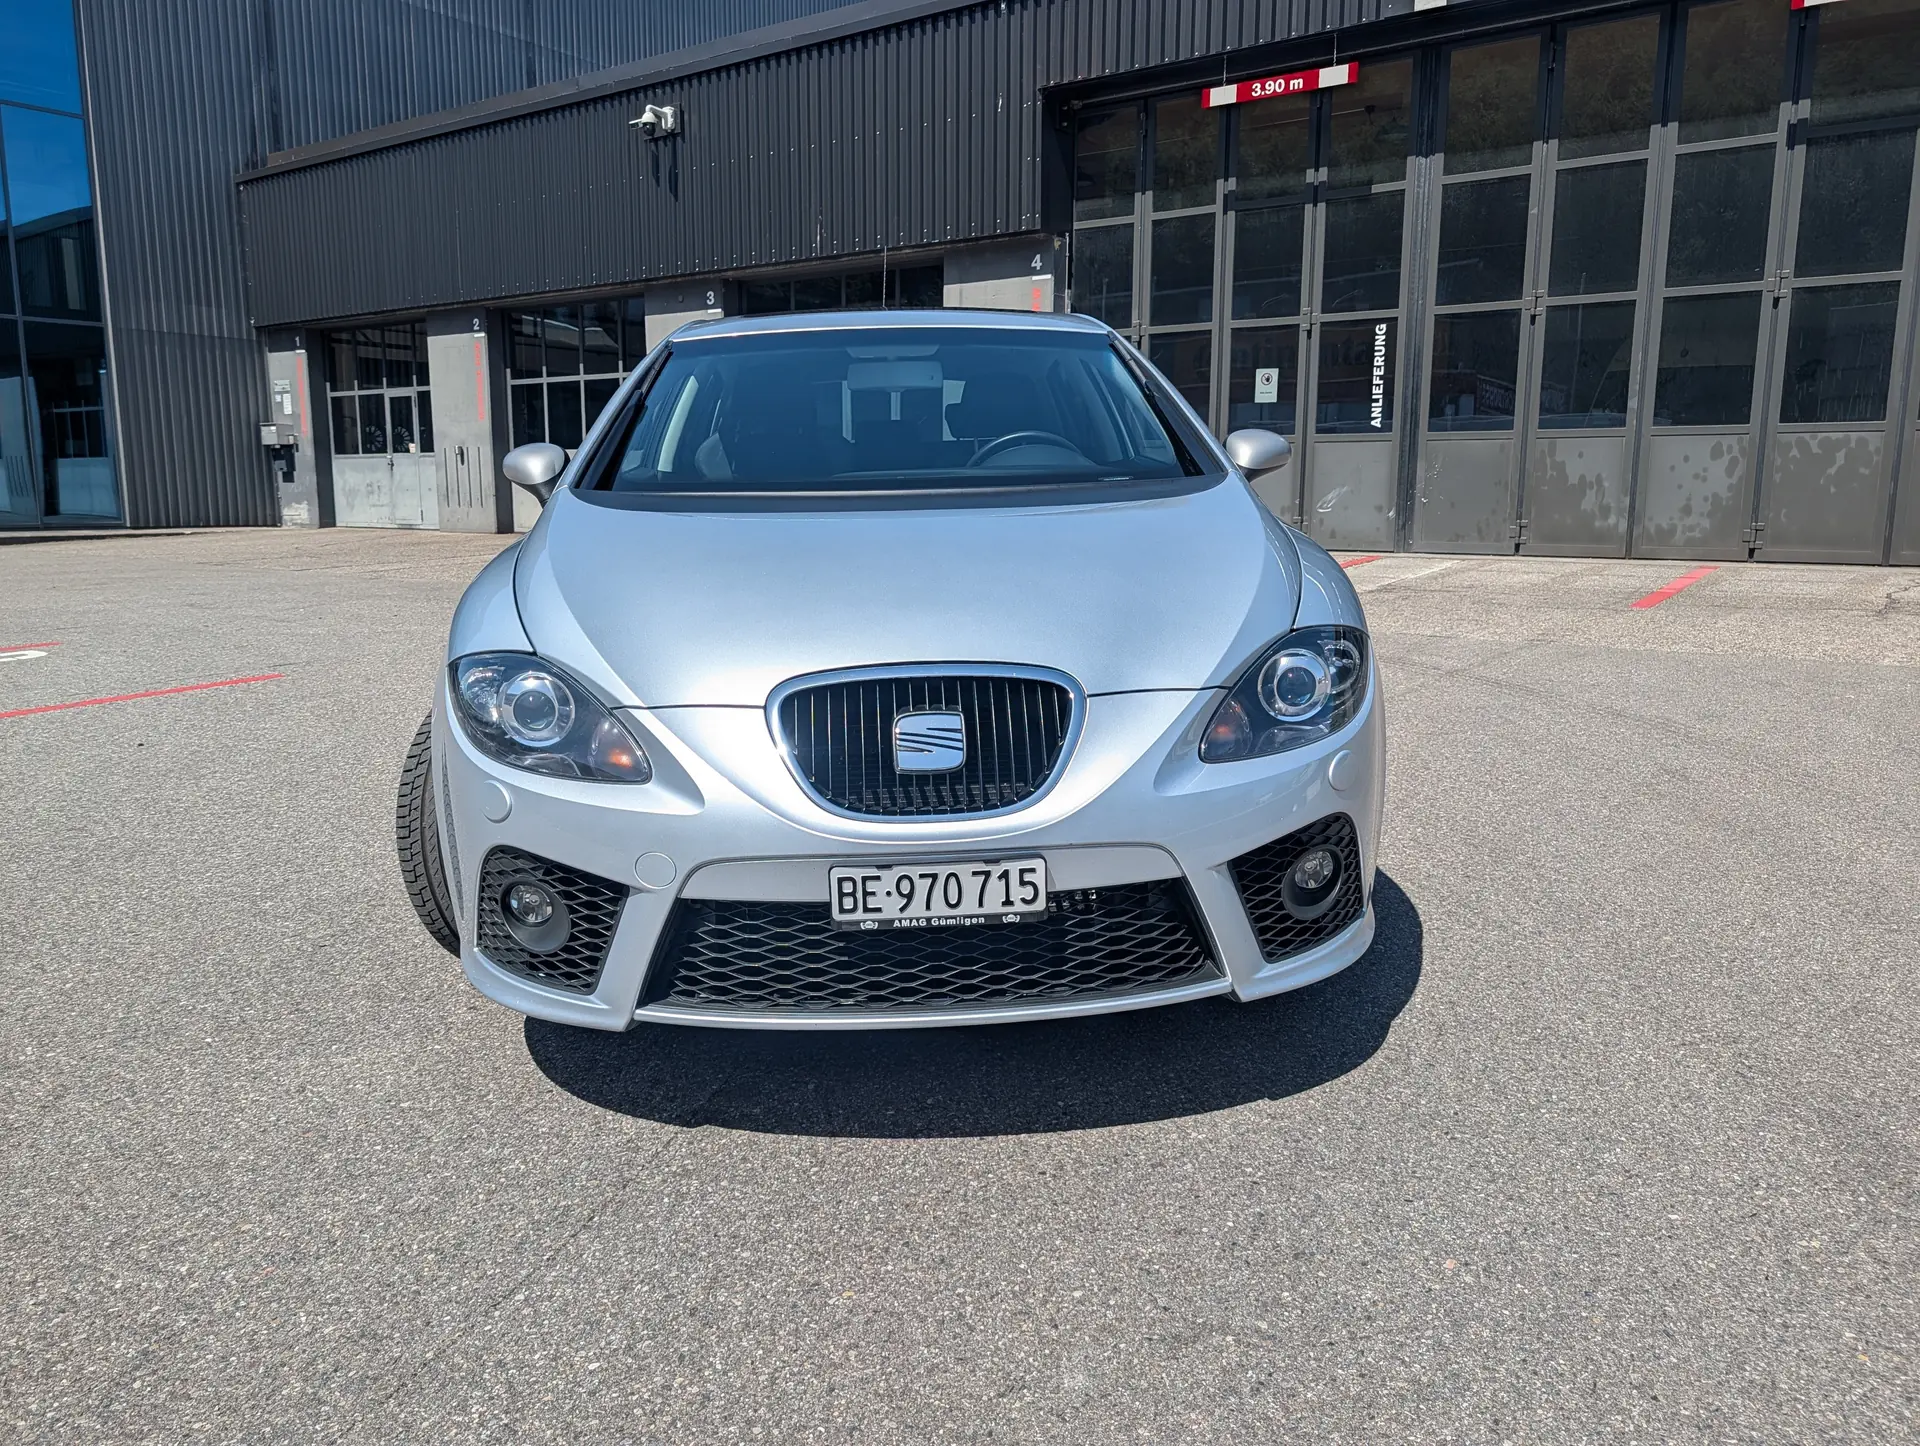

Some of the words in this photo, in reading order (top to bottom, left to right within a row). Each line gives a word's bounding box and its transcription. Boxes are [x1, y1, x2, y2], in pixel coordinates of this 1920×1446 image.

[1251, 78, 1285, 97] 3.90
[1289, 78, 1304, 91] m
[1030, 253, 1043, 271] 4
[706, 290, 715, 306] 3
[473, 318, 480, 330] 2
[295, 336, 300, 347] 1
[1370, 323, 1387, 428] ANLIEFERUNG
[892, 917, 928, 928] AMAG
[931, 916, 985, 926] Gümligen
